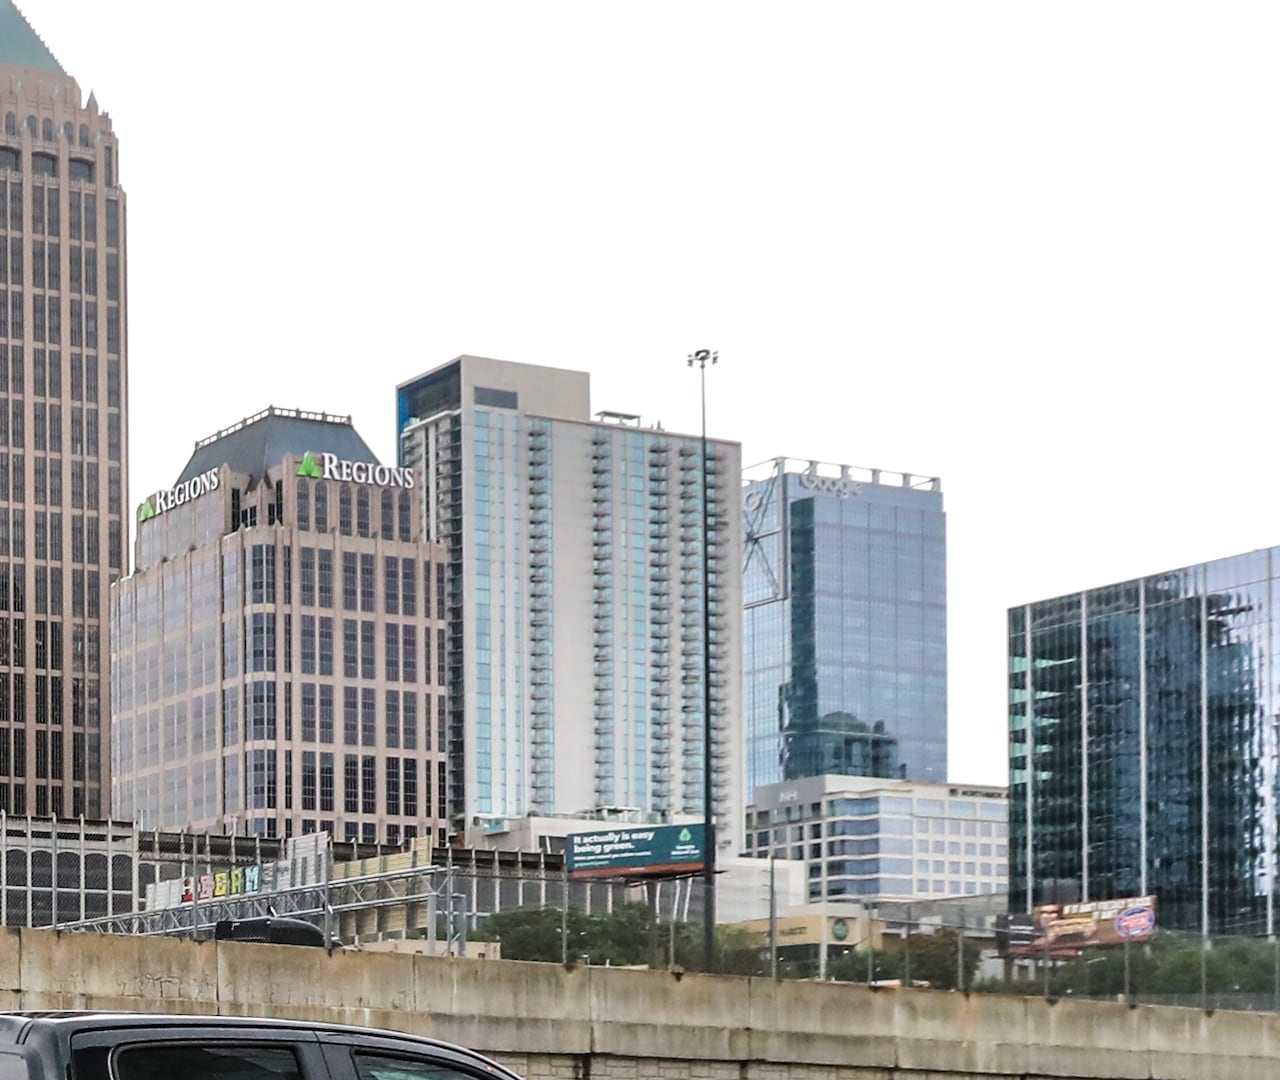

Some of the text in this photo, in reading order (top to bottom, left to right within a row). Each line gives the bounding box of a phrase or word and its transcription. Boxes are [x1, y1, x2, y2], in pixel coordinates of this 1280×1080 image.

[321, 452, 414, 489] REGIONS
[155, 467, 219, 514] REGIONS
[573, 831, 655, 844] It actually is easy
[573, 842, 635, 854] being green.
